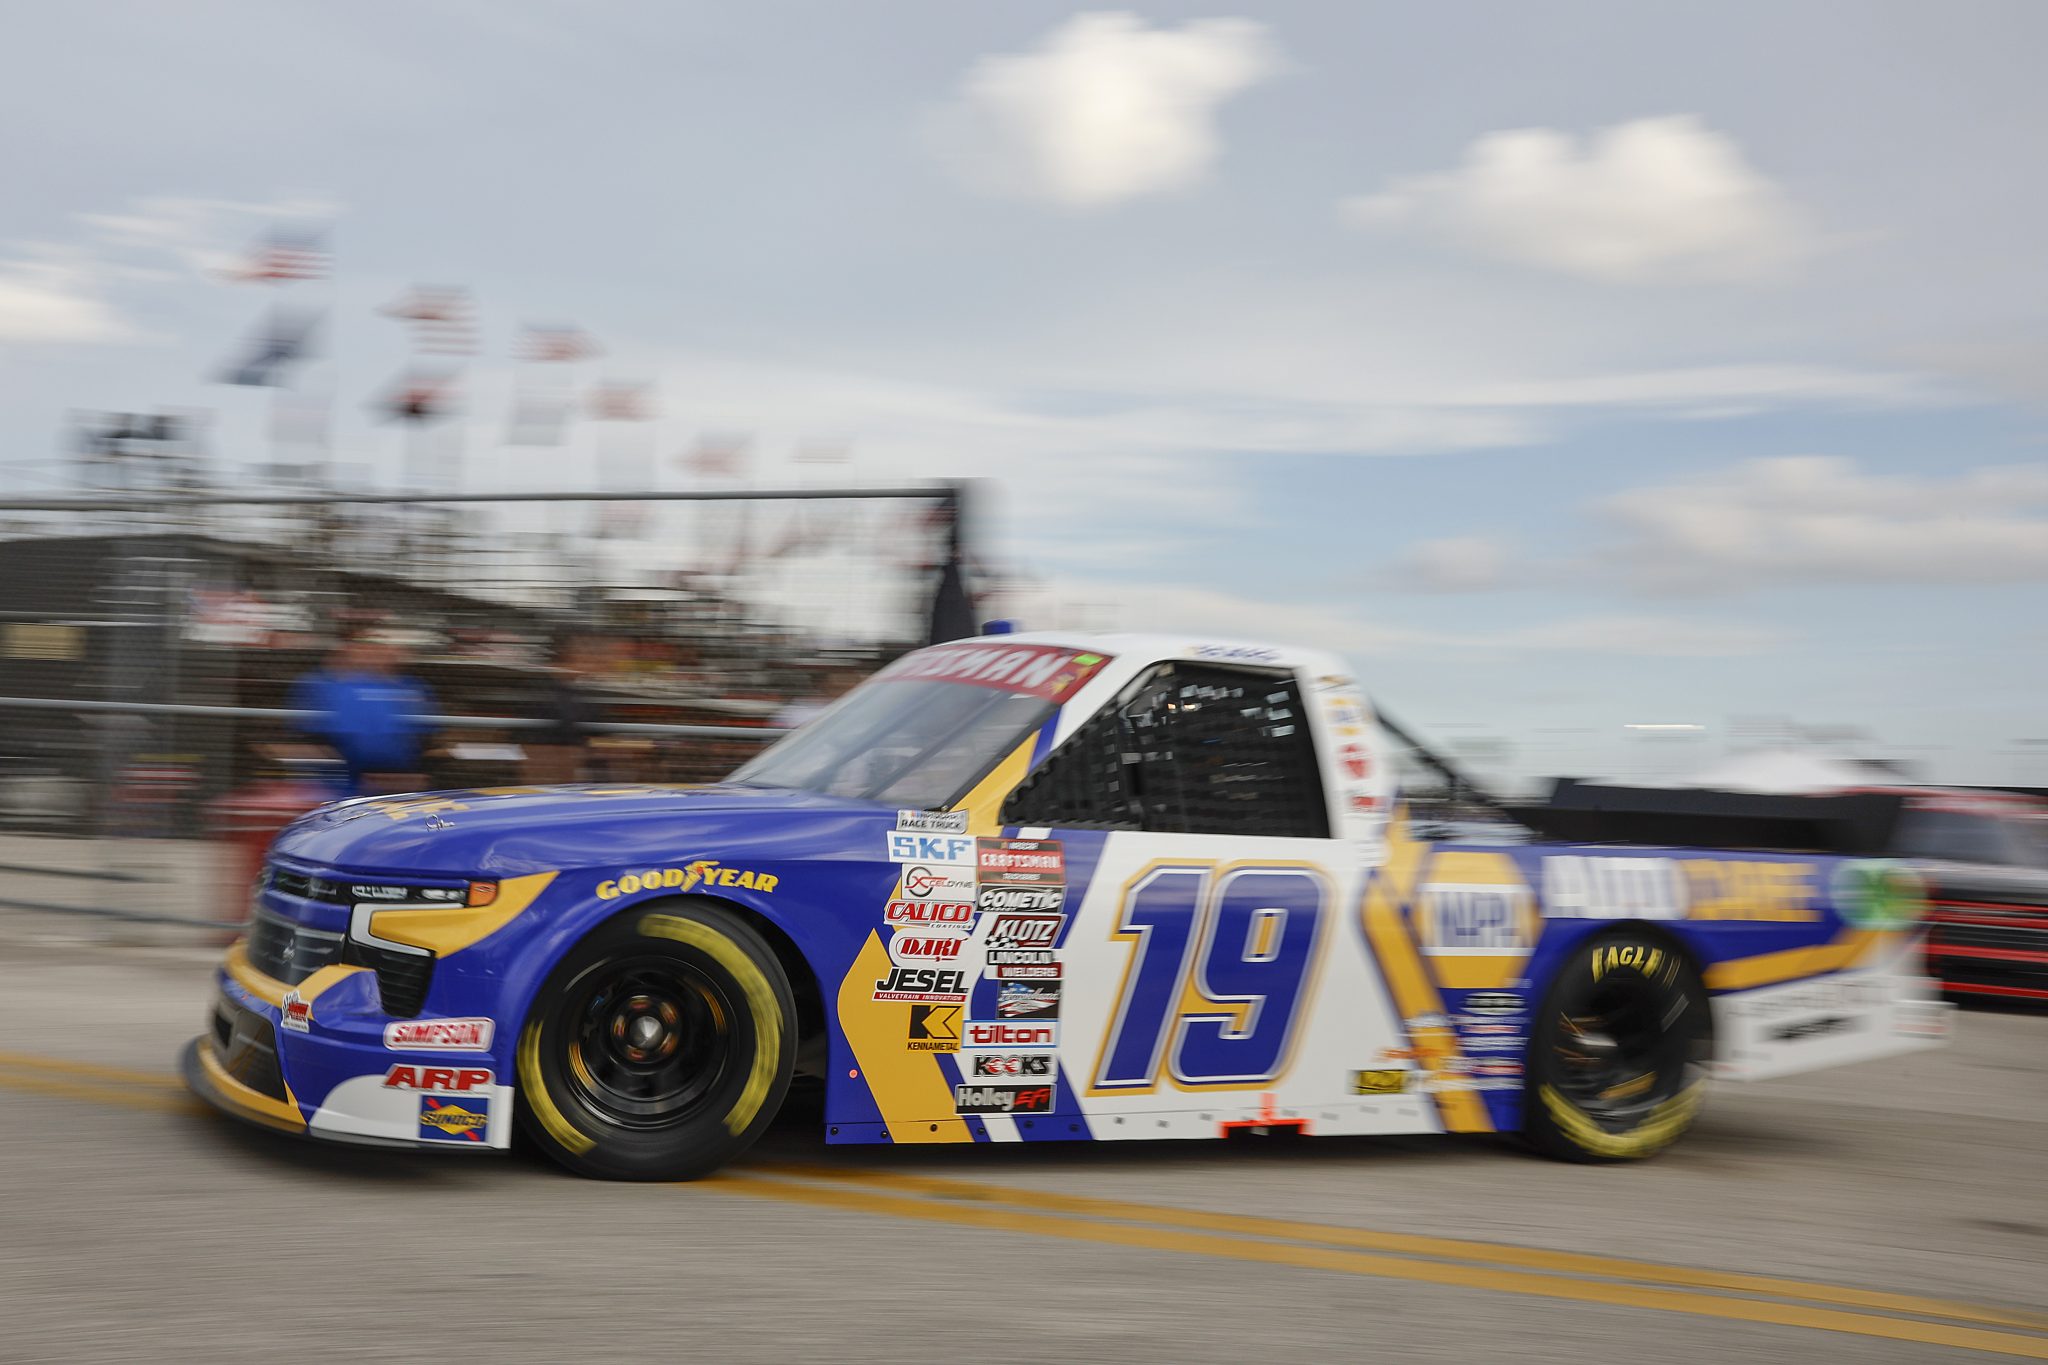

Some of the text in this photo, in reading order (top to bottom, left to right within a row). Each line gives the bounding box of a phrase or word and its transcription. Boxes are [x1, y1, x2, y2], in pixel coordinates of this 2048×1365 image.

[901, 819, 961, 829] RACE TRUCK
[893, 836, 972, 860] SKF
[980, 853, 1061, 868] CRAFTSMAN
[595, 860, 779, 900] GOODYEAR
[978, 890, 1063, 909] COMETIC
[887, 902, 973, 922] CALICO
[994, 919, 1059, 941] KLOTZ
[901, 938, 962, 956] DART
[988, 951, 1052, 964] LINCOLN
[1592, 946, 1662, 984] EAGLE
[876, 968, 969, 993] JESEL
[1084, 858, 1337, 1097] 19
[393, 1023, 483, 1044] SIMPSON
[969, 1025, 1051, 1043] tilton
[907, 1042, 959, 1051] KENNAMETAL
[384, 1066, 490, 1090] ARP
[958, 1087, 1015, 1111] Holley
[420, 1111, 488, 1128] SUNOCO
